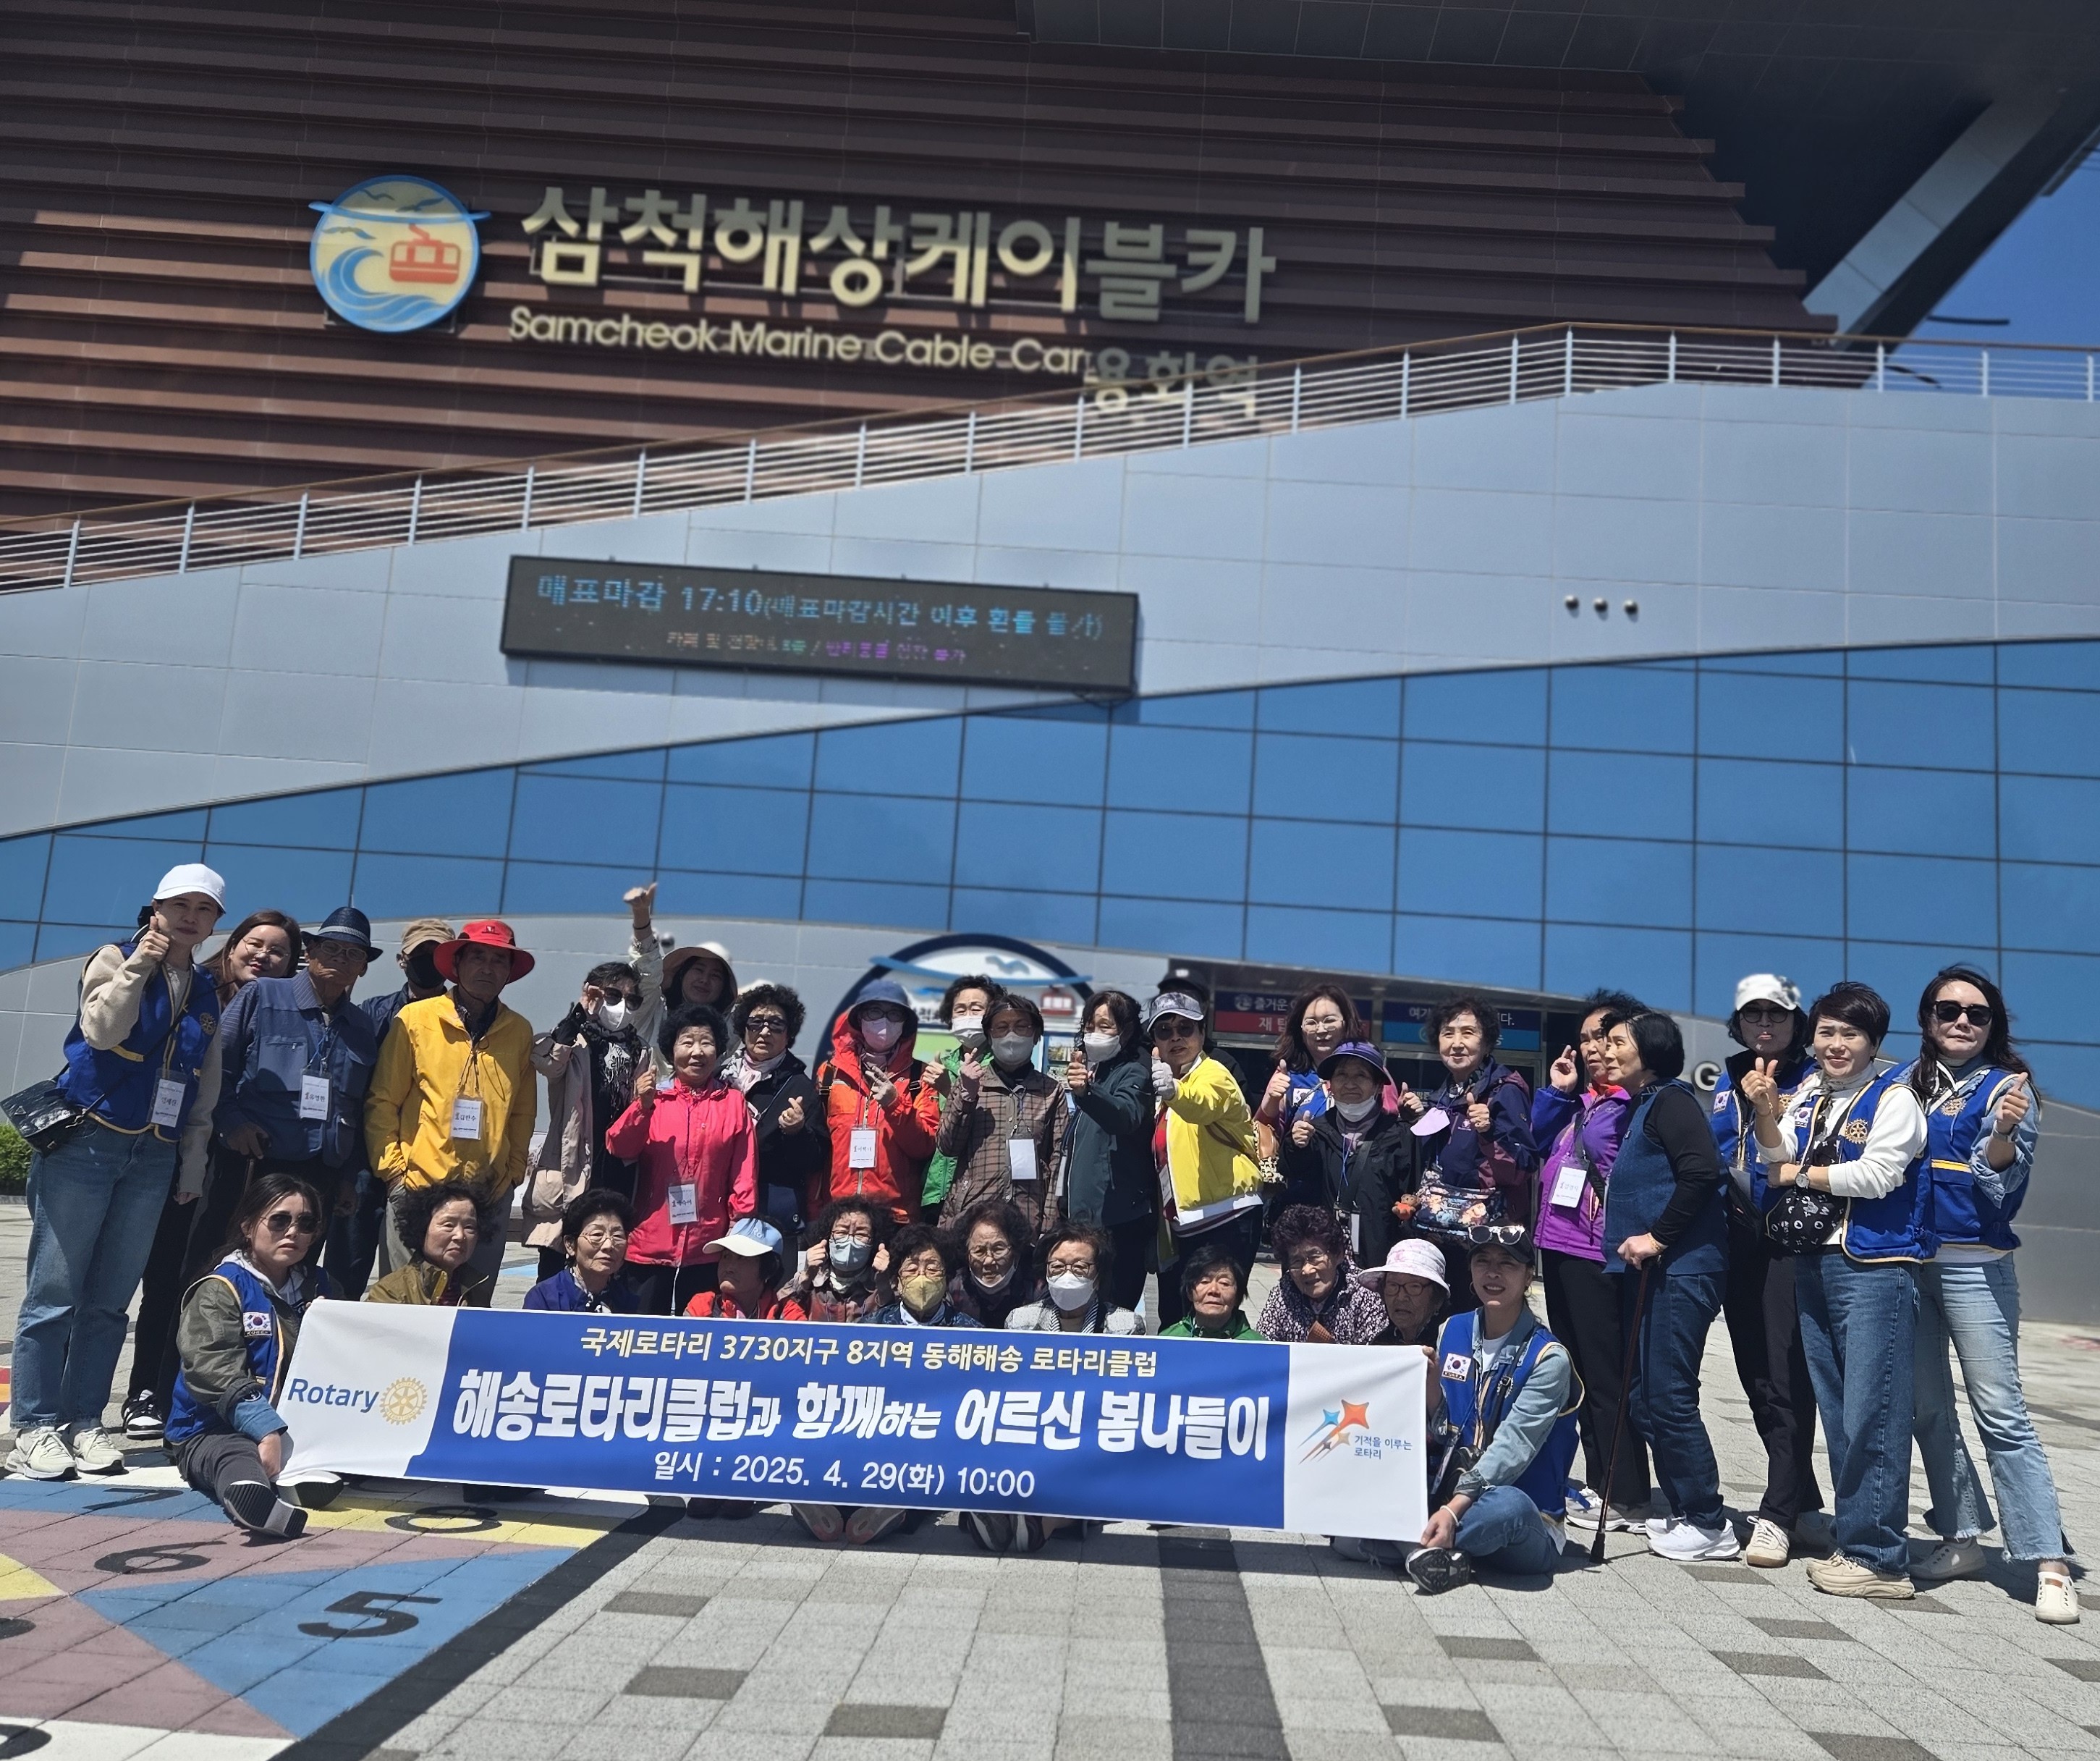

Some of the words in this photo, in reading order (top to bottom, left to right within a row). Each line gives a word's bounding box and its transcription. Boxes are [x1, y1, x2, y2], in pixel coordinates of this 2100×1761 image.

[520, 187, 1276, 324] 삼척해상케이블카
[508, 305, 716, 352] Samcheok
[729, 319, 863, 363] Marine
[874, 330, 994, 371] Cable
[1010, 338, 1083, 374] Car
[537, 575, 666, 612] 매표마감
[1254, 998, 1288, 1012] 즐거운
[580, 1327, 712, 1361] 국제로타리
[719, 1335, 839, 1365] 3730지구
[847, 1340, 913, 1369] 8지역
[921, 1343, 1023, 1373] 동해해송
[1030, 1348, 1156, 1377] 로타리클럽
[288, 1378, 380, 1414] Rotary
[453, 1368, 781, 1443] 해송로타리클럽과
[792, 1382, 941, 1440] 함께하는
[955, 1388, 1085, 1450] 어르신
[1098, 1390, 1269, 1461] 봄나들이
[1354, 1448, 1381, 1460] 로타리
[1355, 1435, 1381, 1448] 기적을
[1384, 1438, 1413, 1450] 이루는
[654, 1451, 703, 1481] 일시
[731, 1455, 810, 1486] 2025.
[823, 1460, 848, 1487] 4.
[861, 1462, 945, 1495] 29(화)
[957, 1467, 1036, 1498] 10:00
[94, 1541, 226, 1574] 6
[297, 1592, 442, 1639] 5
